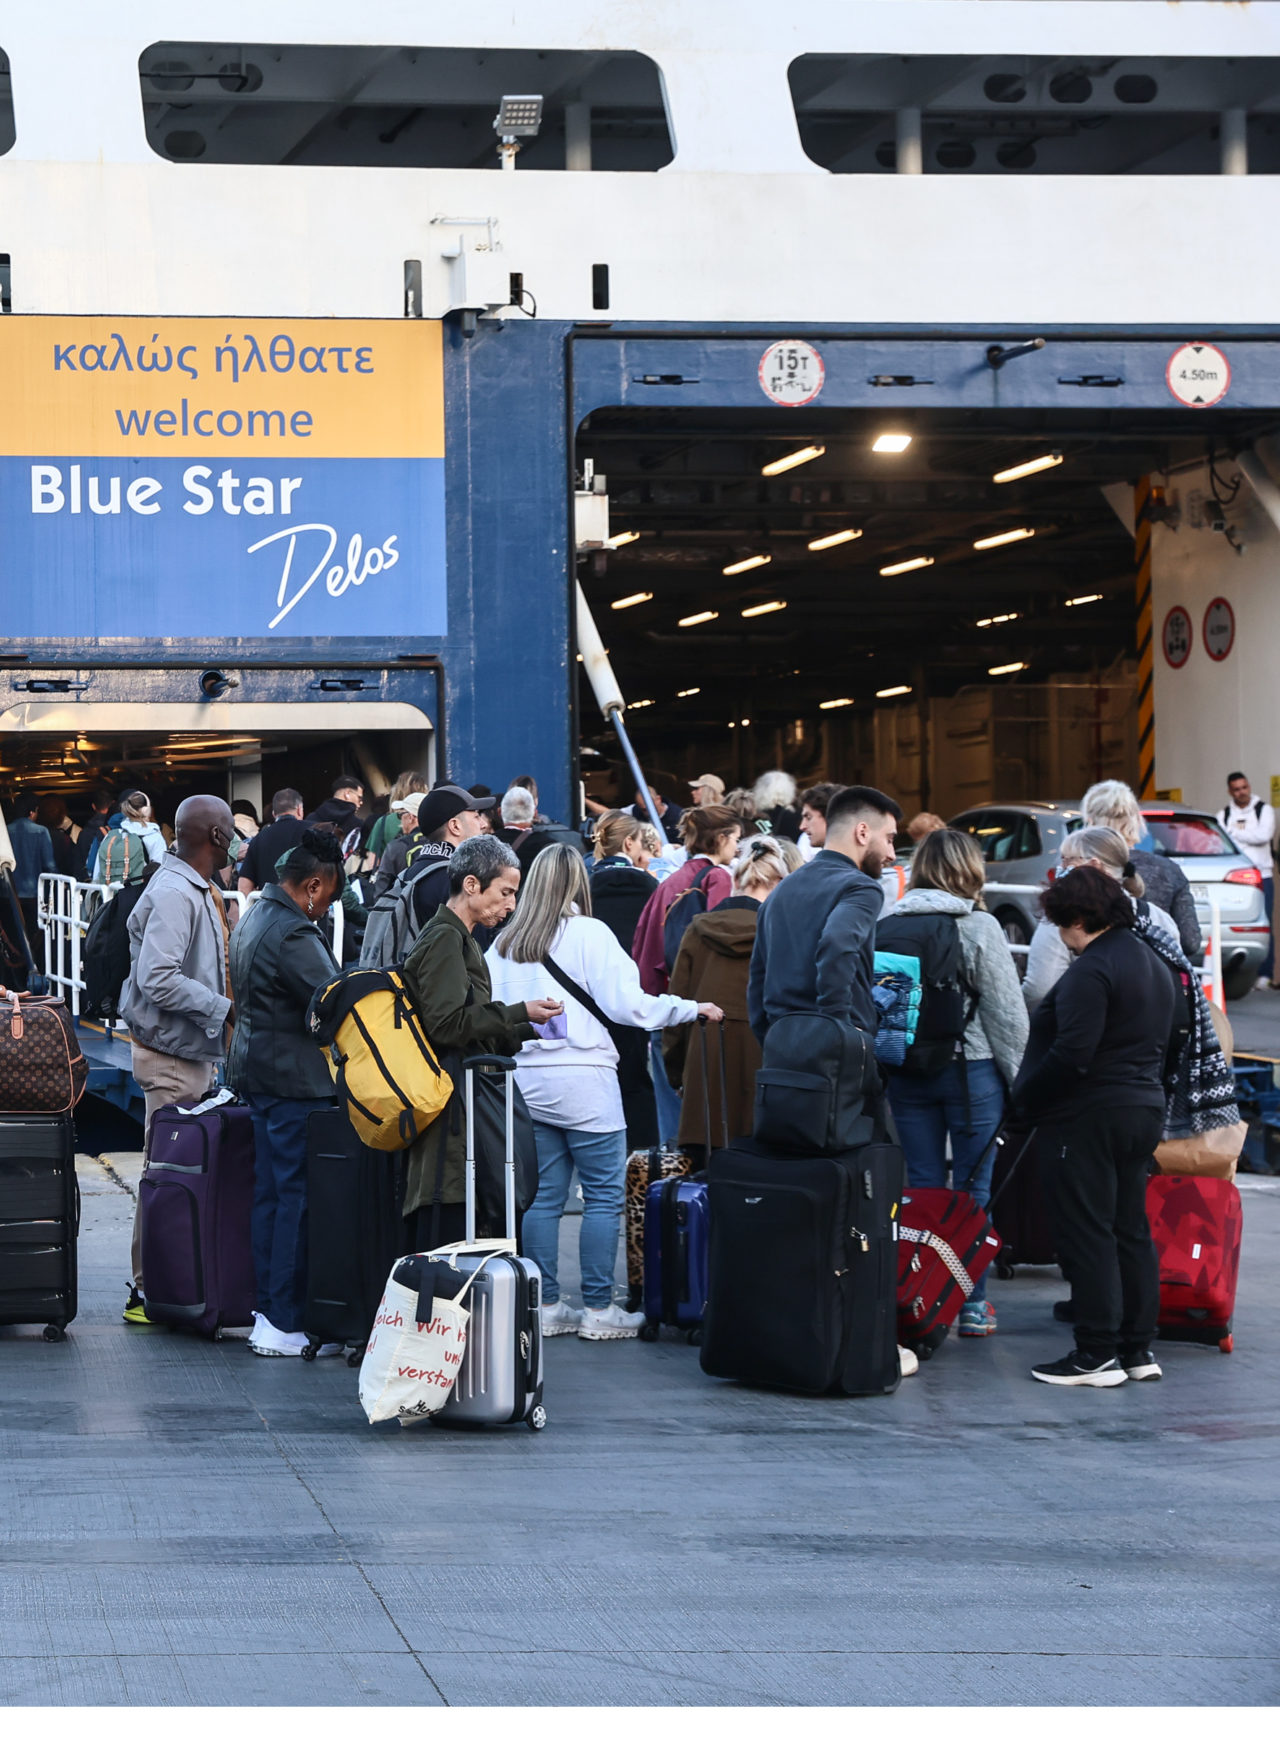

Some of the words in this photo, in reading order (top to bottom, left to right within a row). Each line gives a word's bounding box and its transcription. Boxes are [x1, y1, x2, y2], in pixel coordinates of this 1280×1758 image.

[53, 332, 199, 381] καλώς
[215, 333, 375, 383] ήλθατε
[1179, 369, 1218, 381] 4.50m
[115, 398, 314, 438] welcome
[30, 464, 164, 516] Blue
[182, 464, 303, 516] Star
[246, 522, 400, 630] Delos
[417, 1317, 452, 1336] Wir
